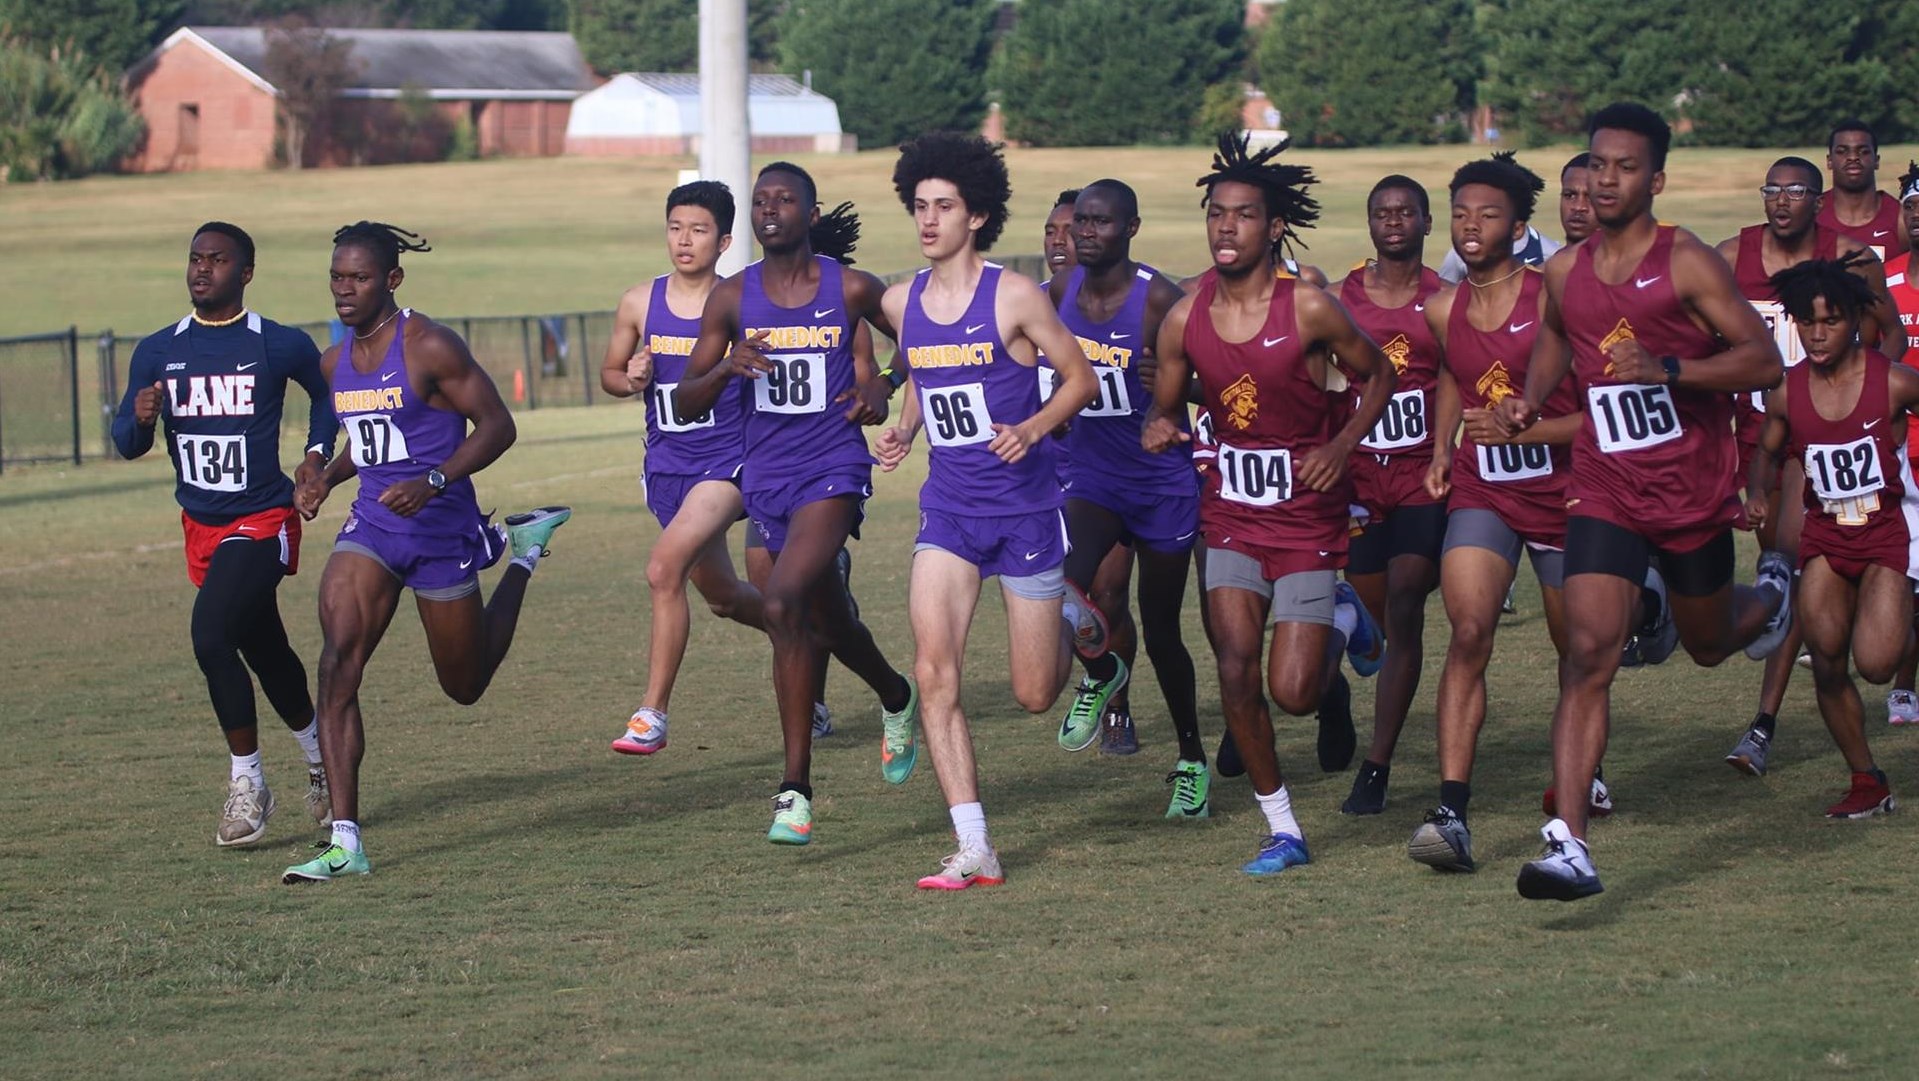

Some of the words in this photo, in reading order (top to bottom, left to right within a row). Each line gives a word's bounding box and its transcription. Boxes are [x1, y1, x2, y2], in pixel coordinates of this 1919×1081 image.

[908, 342, 994, 368] BENEDICT
[166, 375, 255, 417] LANE
[334, 386, 404, 413] BENEDICT
[767, 359, 812, 407] 98
[929, 391, 979, 441] 96
[1596, 387, 1676, 443] 105
[182, 439, 245, 485] 134
[358, 418, 391, 466] 97
[1223, 450, 1290, 499] 104
[1812, 443, 1881, 493] 182
